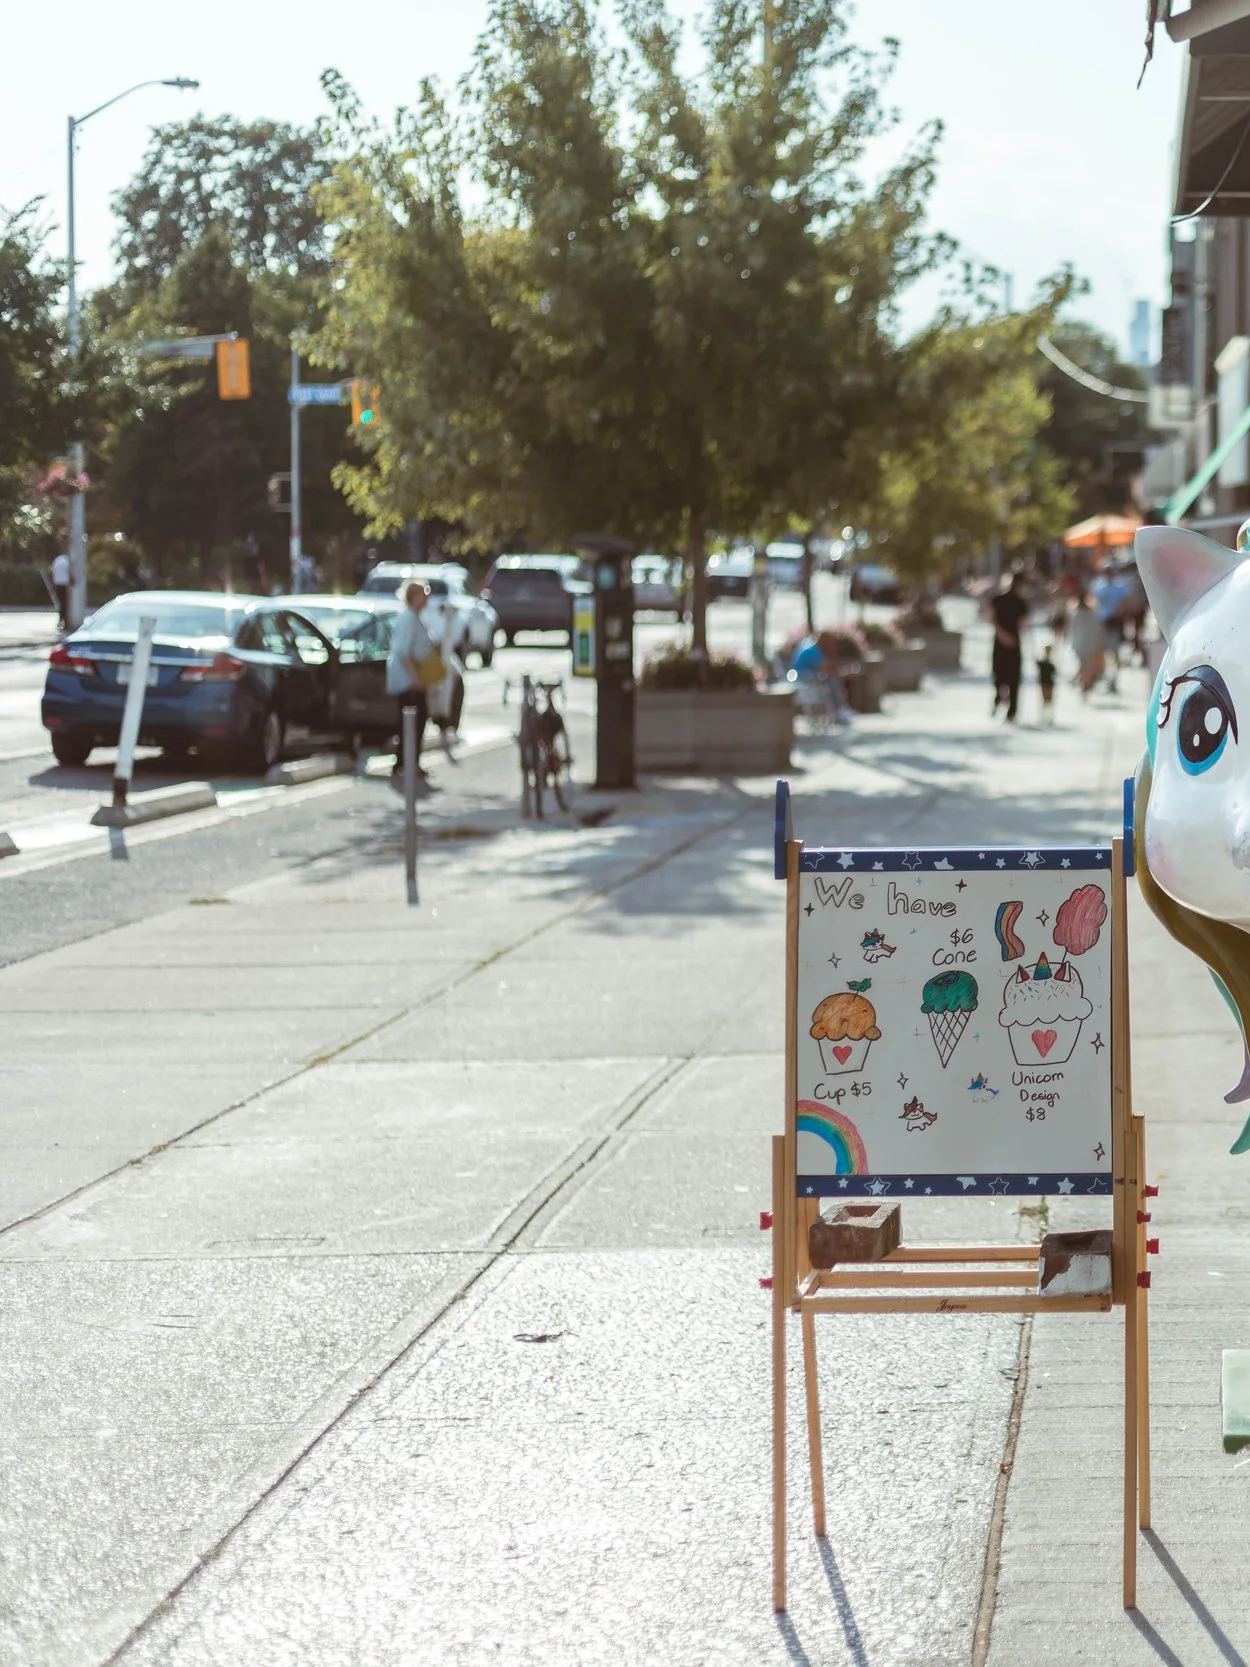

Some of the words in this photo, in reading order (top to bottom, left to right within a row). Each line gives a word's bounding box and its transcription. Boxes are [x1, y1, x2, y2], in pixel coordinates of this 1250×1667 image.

[814, 877, 865, 910] We
[887, 881, 957, 917] have
[950, 928, 974, 947] $6
[932, 948, 978, 966] Cone
[1012, 1071, 1065, 1087] Unicorn
[813, 1083, 847, 1105] Cup
[850, 1082, 873, 1098] $5
[1020, 1089, 1061, 1107] Design
[1024, 1106, 1047, 1122] $8
